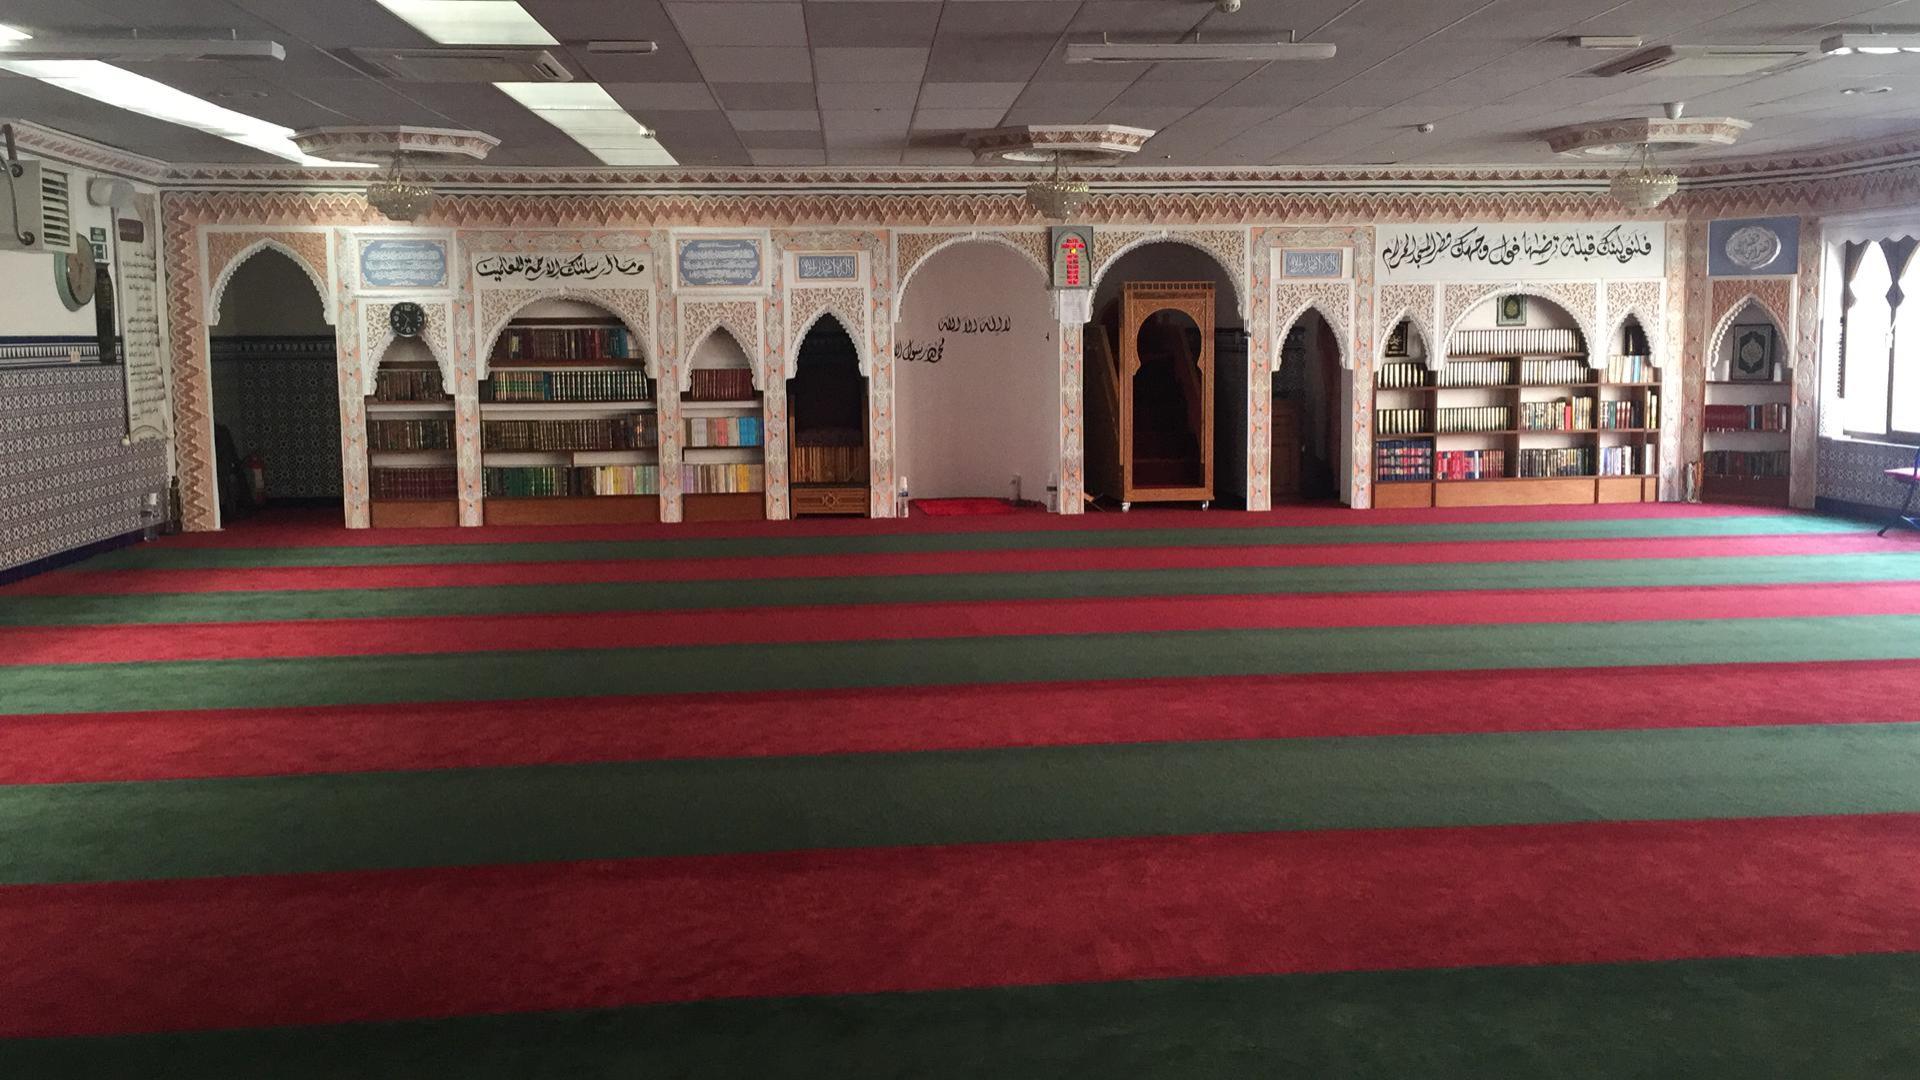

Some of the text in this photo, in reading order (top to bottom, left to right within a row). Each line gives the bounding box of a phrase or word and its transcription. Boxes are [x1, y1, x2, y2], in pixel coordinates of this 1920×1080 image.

[1450, 226, 1489, 261] وجهك
[1488, 234, 1520, 265] فول
[1560, 232, 1595, 262] قبلة
[938, 316, 961, 332] الله
